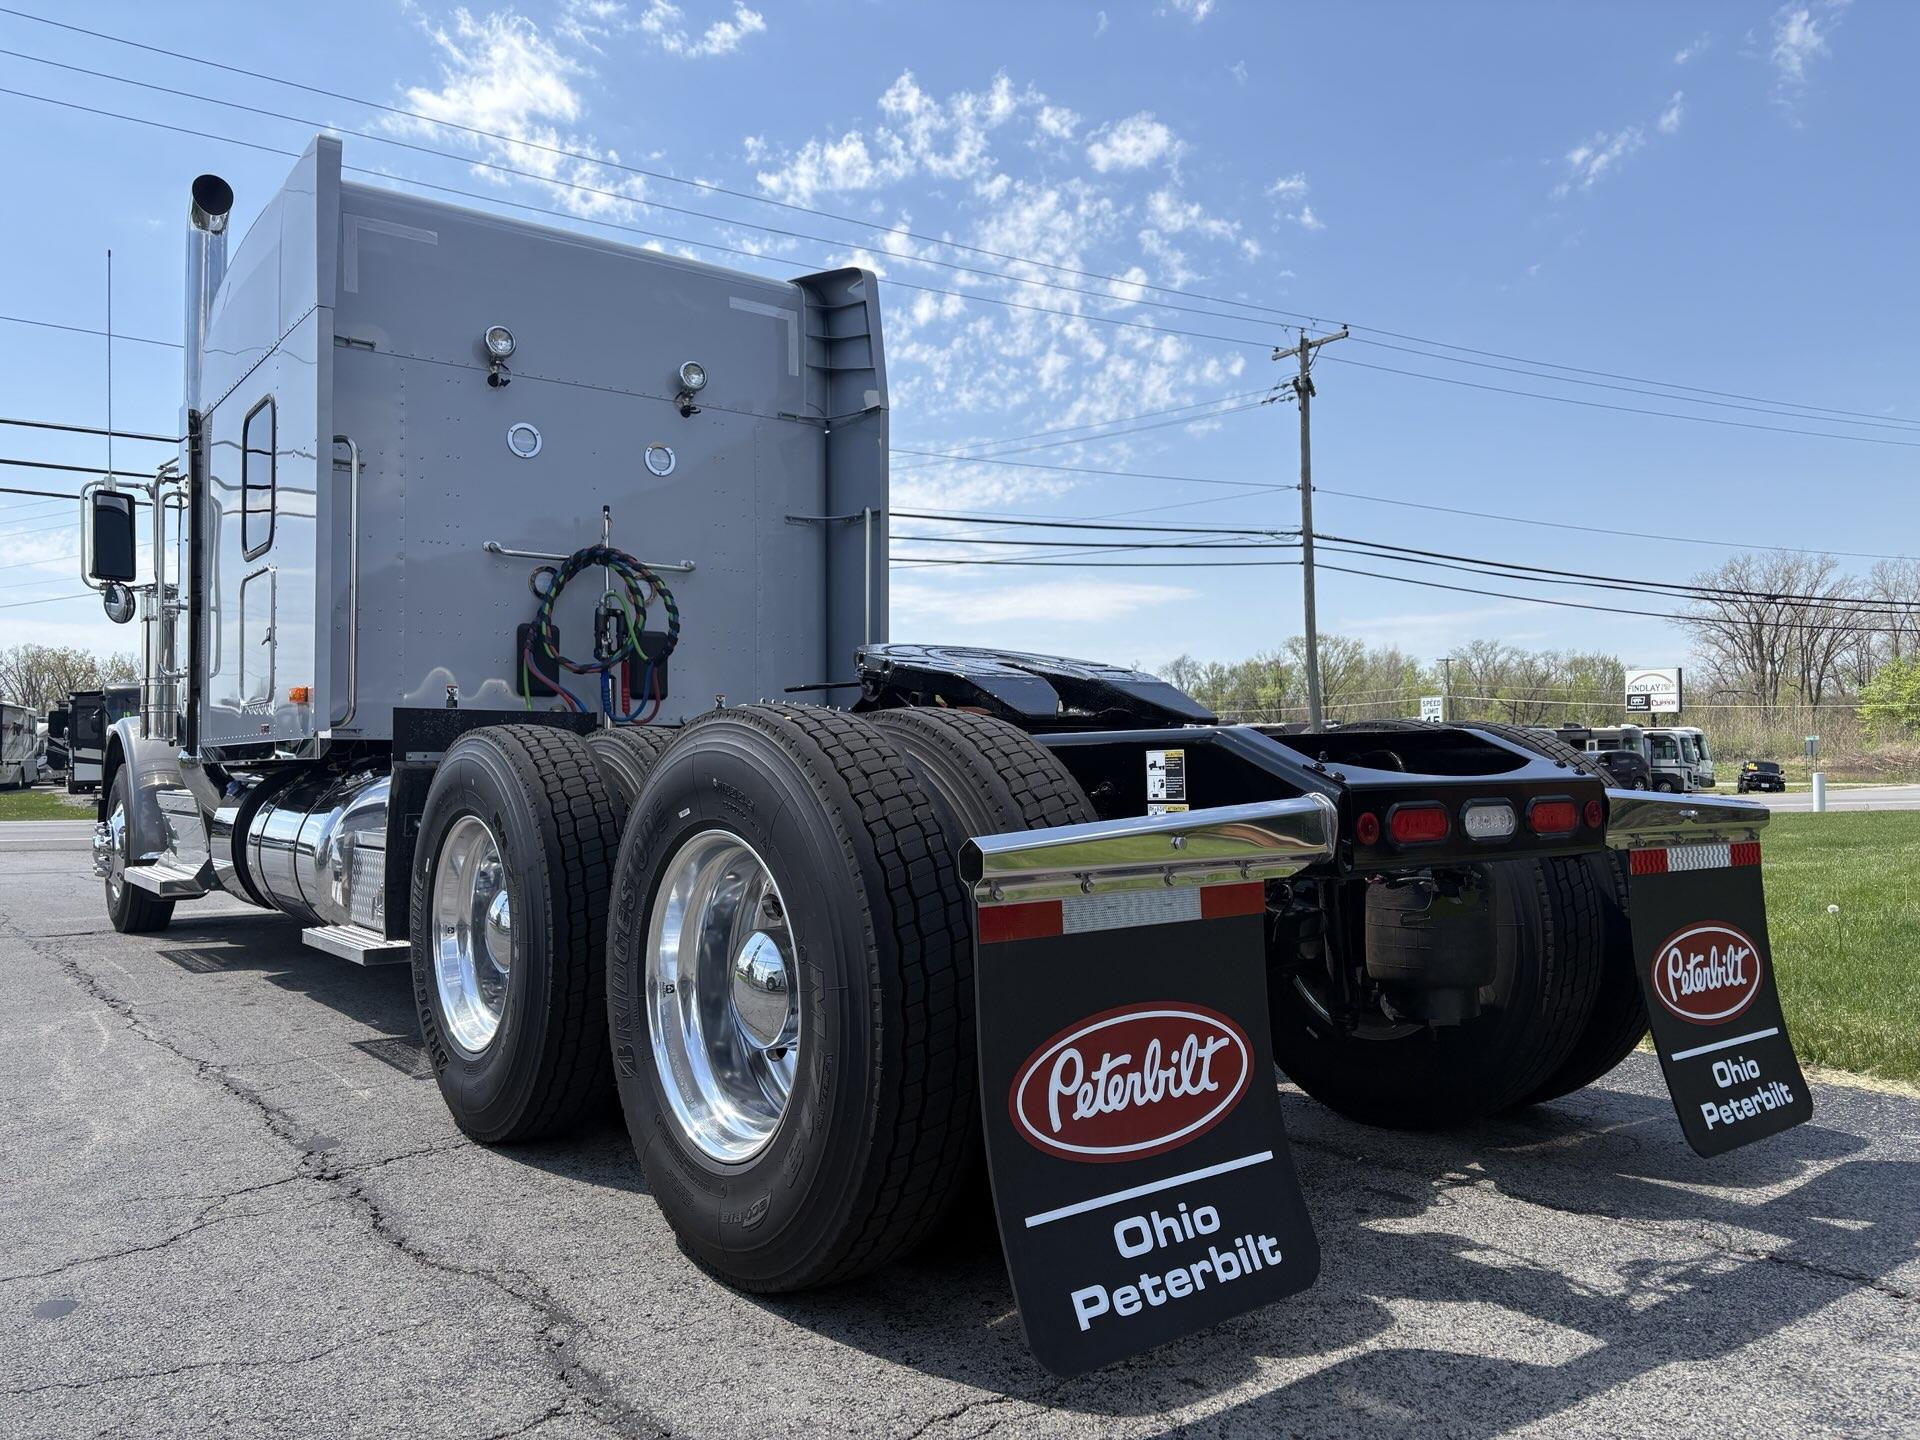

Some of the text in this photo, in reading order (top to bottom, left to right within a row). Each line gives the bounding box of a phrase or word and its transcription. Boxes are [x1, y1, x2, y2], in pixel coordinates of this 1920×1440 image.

[1424, 707, 1439, 715] LIMIT
[1628, 684, 1660, 692] FINDLAY
[1667, 943, 1750, 1002] Peterbilt
[1047, 1035, 1230, 1133] Peterbilt
[1712, 1055, 1761, 1088] Ohio
[1700, 1081, 1794, 1130] Peterbilt
[1113, 1202, 1221, 1259] Ohio
[1070, 1234, 1282, 1332] Peterbilt
